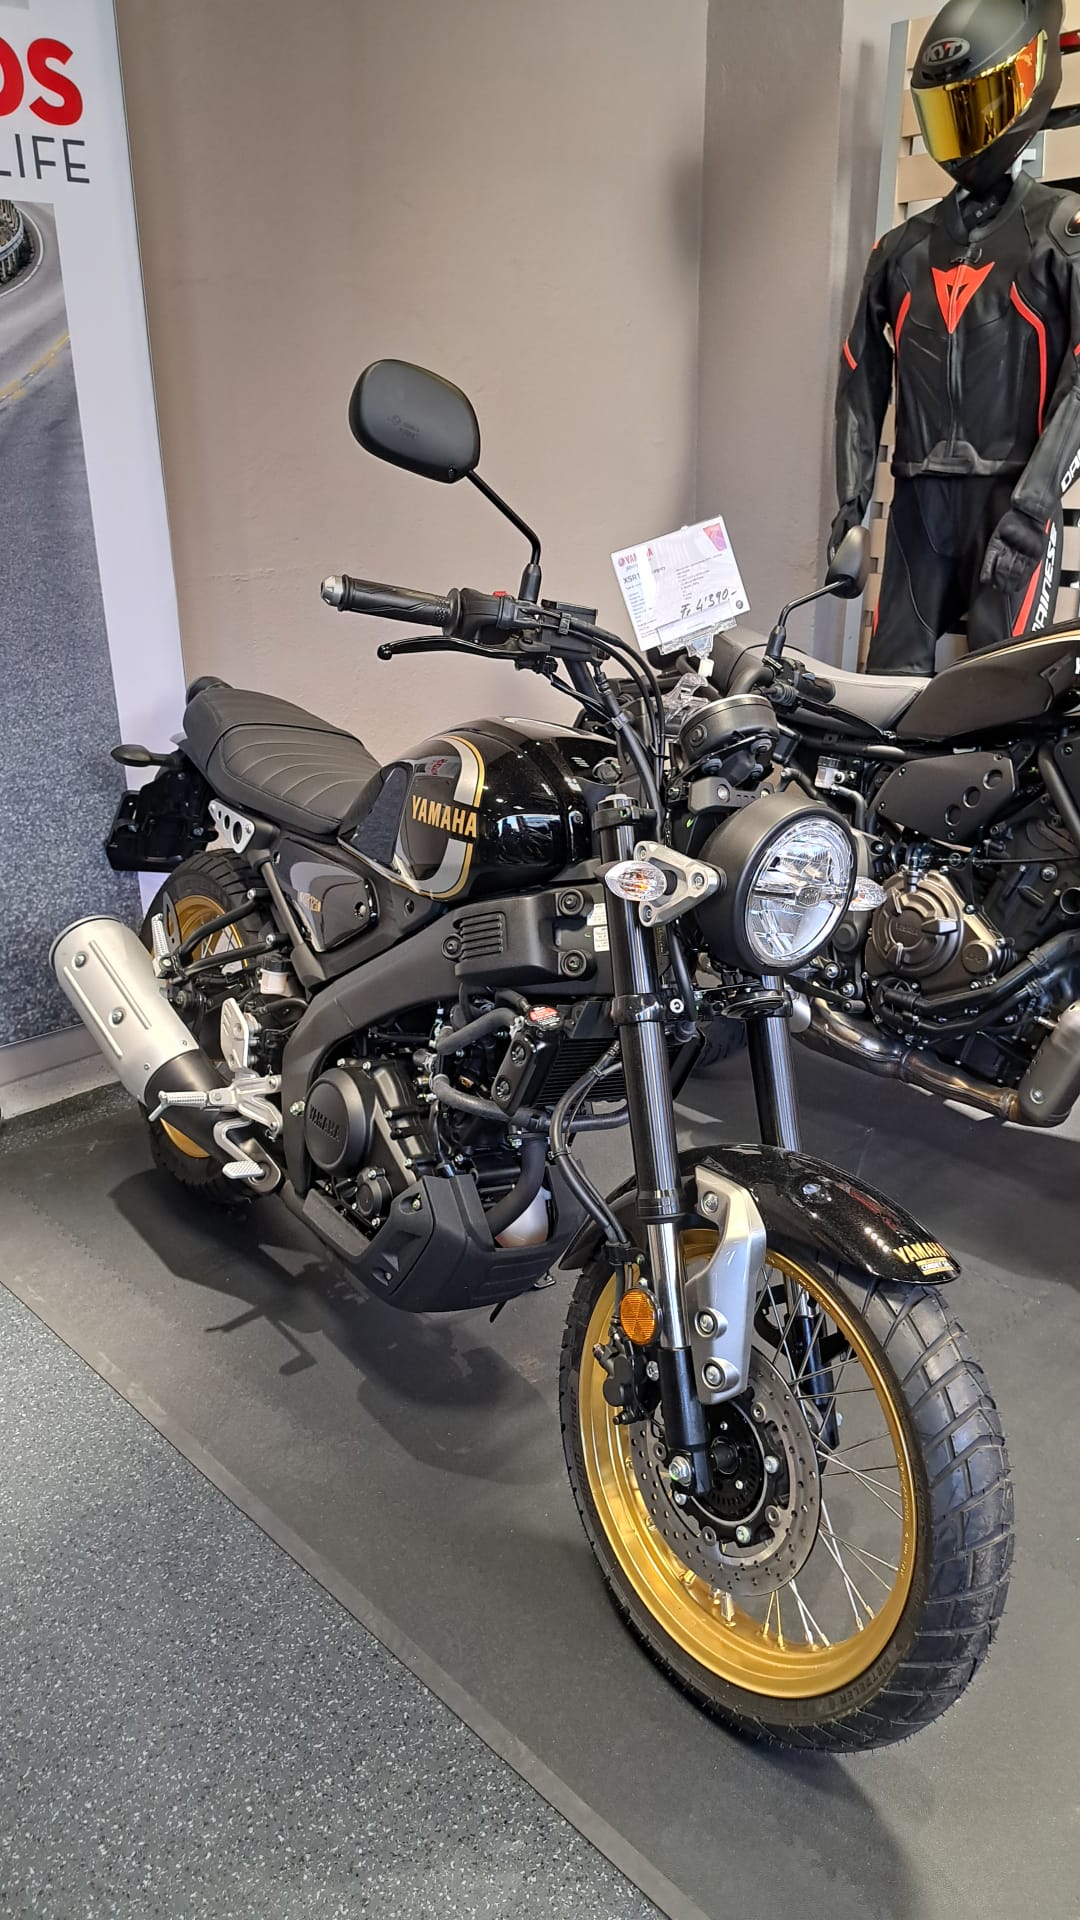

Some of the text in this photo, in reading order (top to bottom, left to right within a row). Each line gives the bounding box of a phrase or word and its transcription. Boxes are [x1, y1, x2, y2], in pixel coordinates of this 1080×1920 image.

[411, 794, 479, 839] YAMAHA
[309, 1104, 341, 1141] YAMAHA
[892, 1241, 950, 1264] YAMAHA
